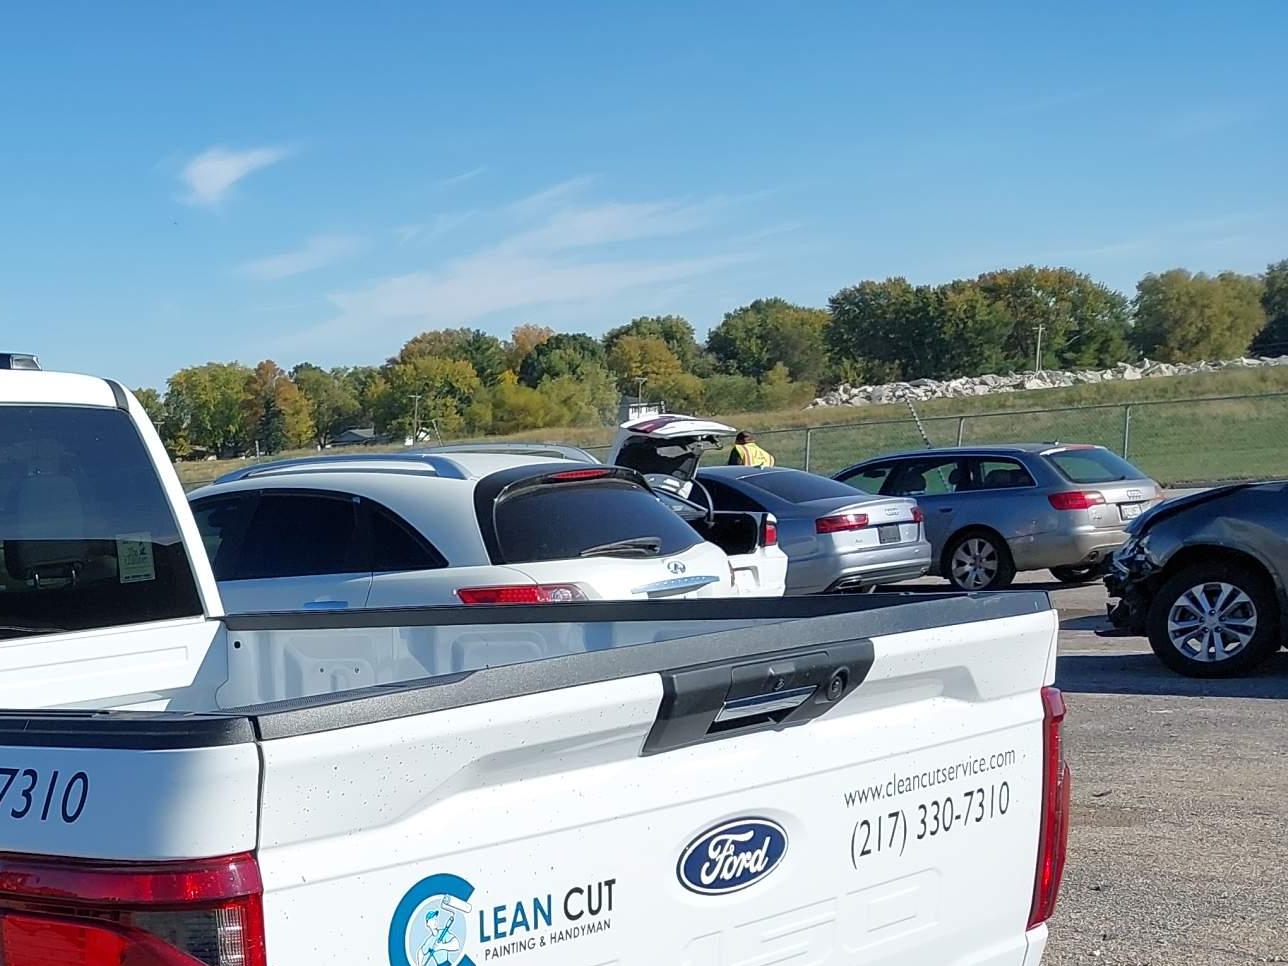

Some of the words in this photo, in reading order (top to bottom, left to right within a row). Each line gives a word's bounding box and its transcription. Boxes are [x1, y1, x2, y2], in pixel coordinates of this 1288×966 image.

[844, 749, 1015, 808] www.cleancutservice.com
[850, 809, 907, 870] (217)
[915, 781, 1010, 840] 330-7310
[700, 829, 771, 885] Ford
[563, 878, 617, 921] CUT
[484, 937, 536, 961] PAINTING
[539, 935, 547, 948] &
[550, 918, 612, 945] HANDYMAN
